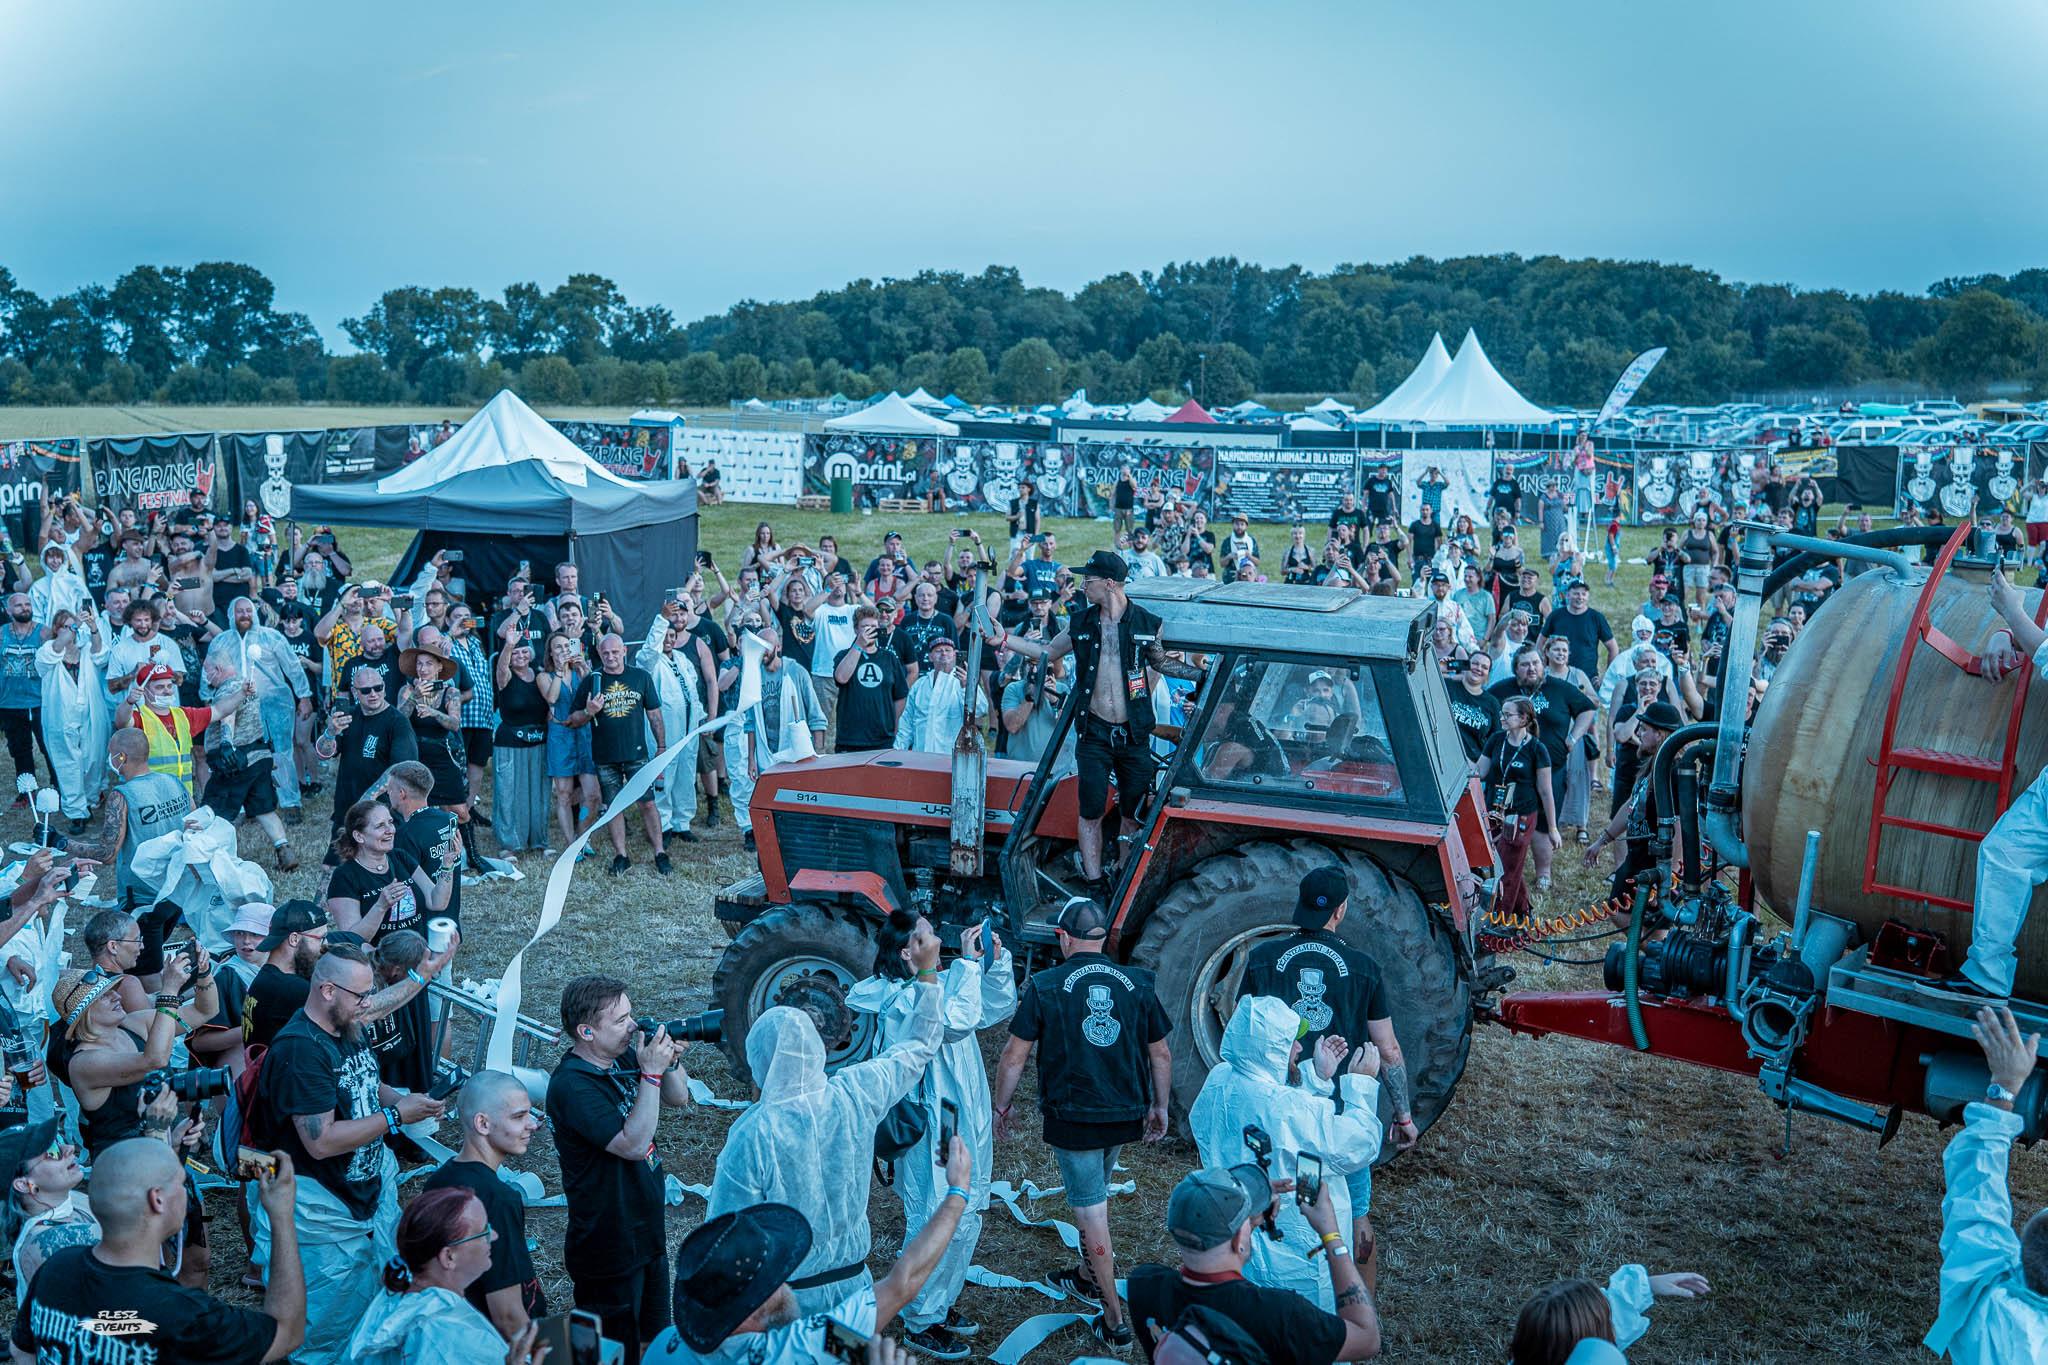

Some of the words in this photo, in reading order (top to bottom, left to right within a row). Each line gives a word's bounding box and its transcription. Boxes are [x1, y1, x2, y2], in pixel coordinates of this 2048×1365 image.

[1276, 452, 1312, 464] ANIMACJI
[1313, 453, 1328, 465] DLA
[95, 462, 197, 499] BANGARANG
[1086, 466, 1186, 490] BANARANG
[138, 488, 193, 510] FESTIVA
[1454, 713, 1481, 730] TEAM
[796, 793, 818, 802] 914
[920, 804, 1000, 820] URS
[381, 913, 422, 930] DREMING
